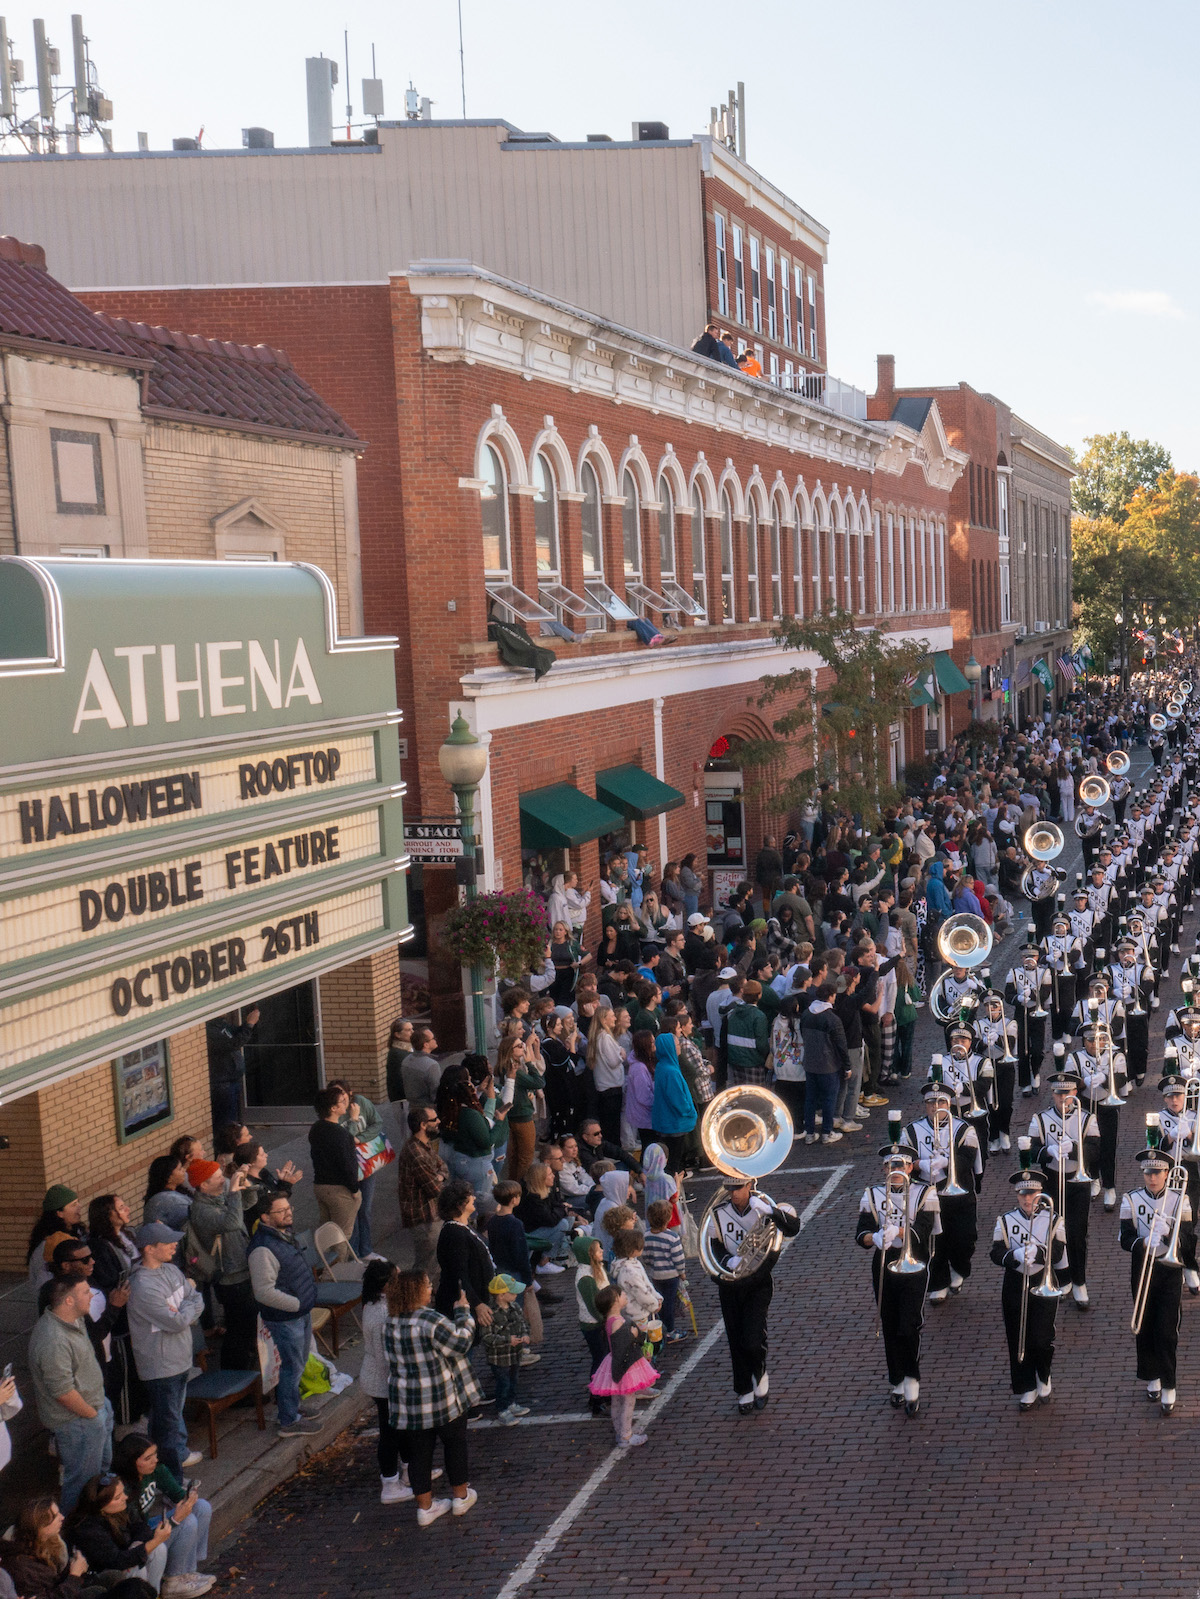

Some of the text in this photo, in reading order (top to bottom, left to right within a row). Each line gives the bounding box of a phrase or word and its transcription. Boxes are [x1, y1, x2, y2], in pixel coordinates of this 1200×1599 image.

[73, 636, 323, 734] ATHENA
[20, 747, 341, 844] HALLOWEEN ROOFTOP
[416, 827, 462, 837] SHACK
[80, 826, 341, 932] DOUBLE FEATURE
[111, 910, 320, 1017] OCTOBER 26TH
[948, 987, 958, 998] OH
[1181, 1046, 1194, 1060] OH
[948, 1066, 964, 1081] OHI
[1138, 1205, 1154, 1224] OH
[727, 1222, 743, 1241] OH
[1012, 1225, 1028, 1243] OH
